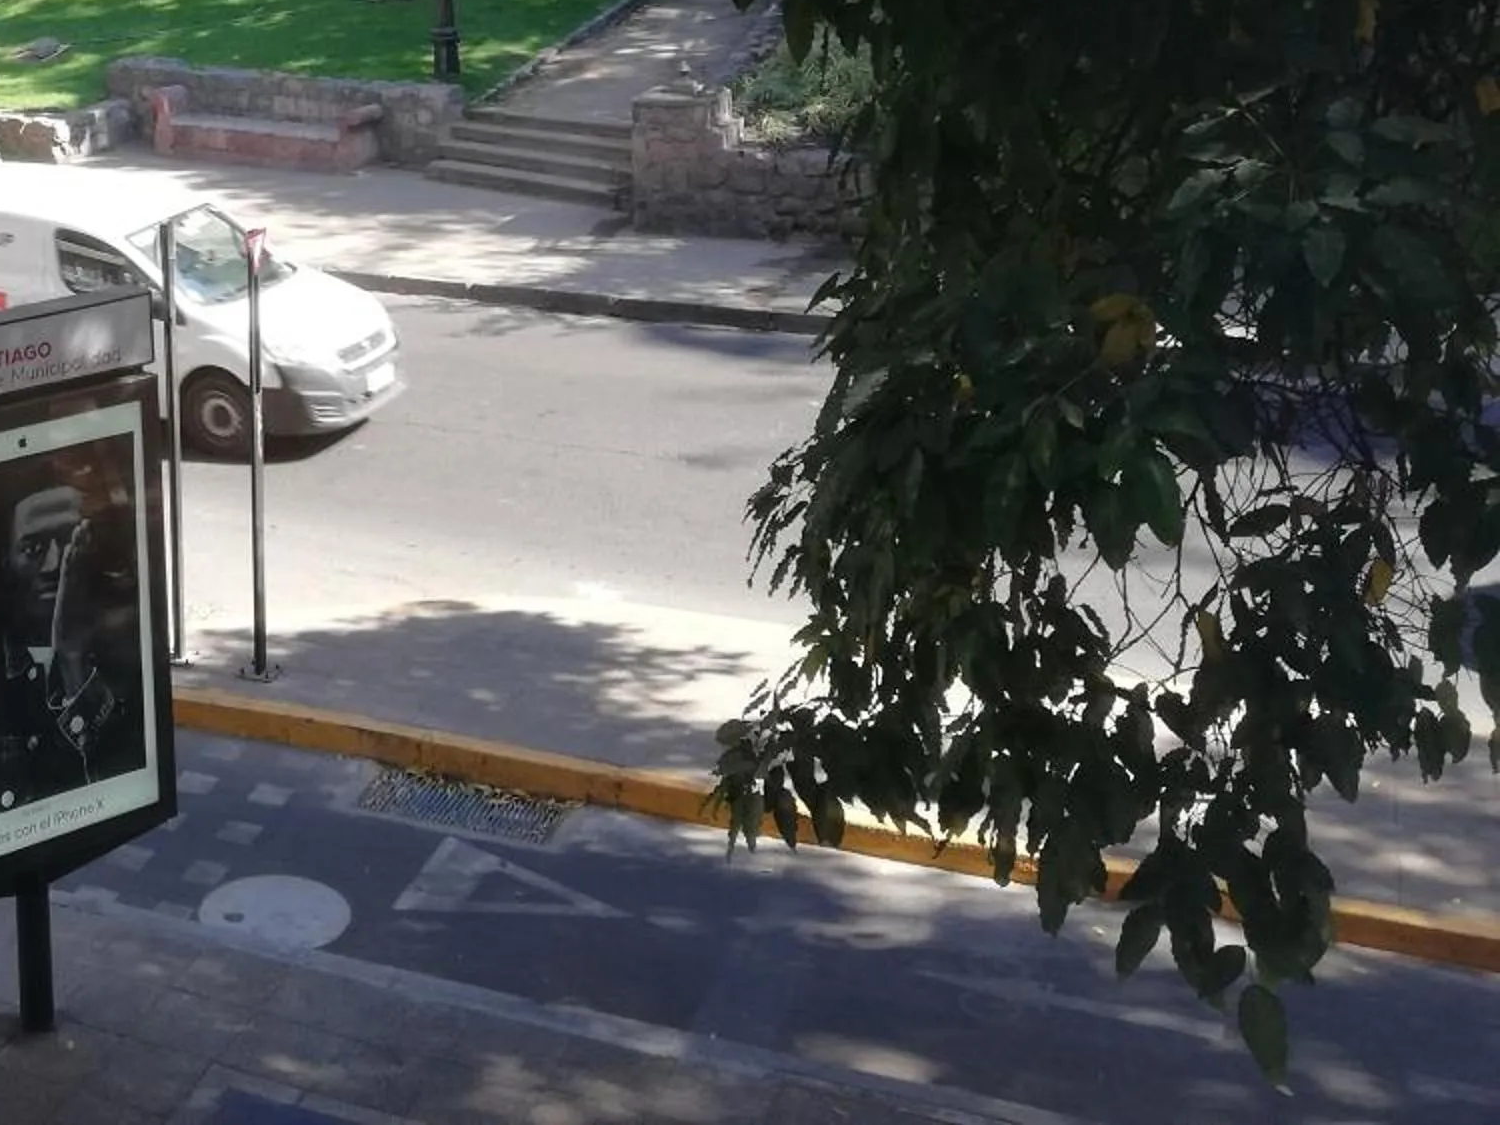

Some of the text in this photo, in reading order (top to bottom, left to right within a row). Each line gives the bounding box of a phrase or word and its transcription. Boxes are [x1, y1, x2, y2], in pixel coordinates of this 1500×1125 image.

[15, 824, 37, 840] con
[40, 814, 51, 829] el
[54, 805, 93, 826] iPhone
